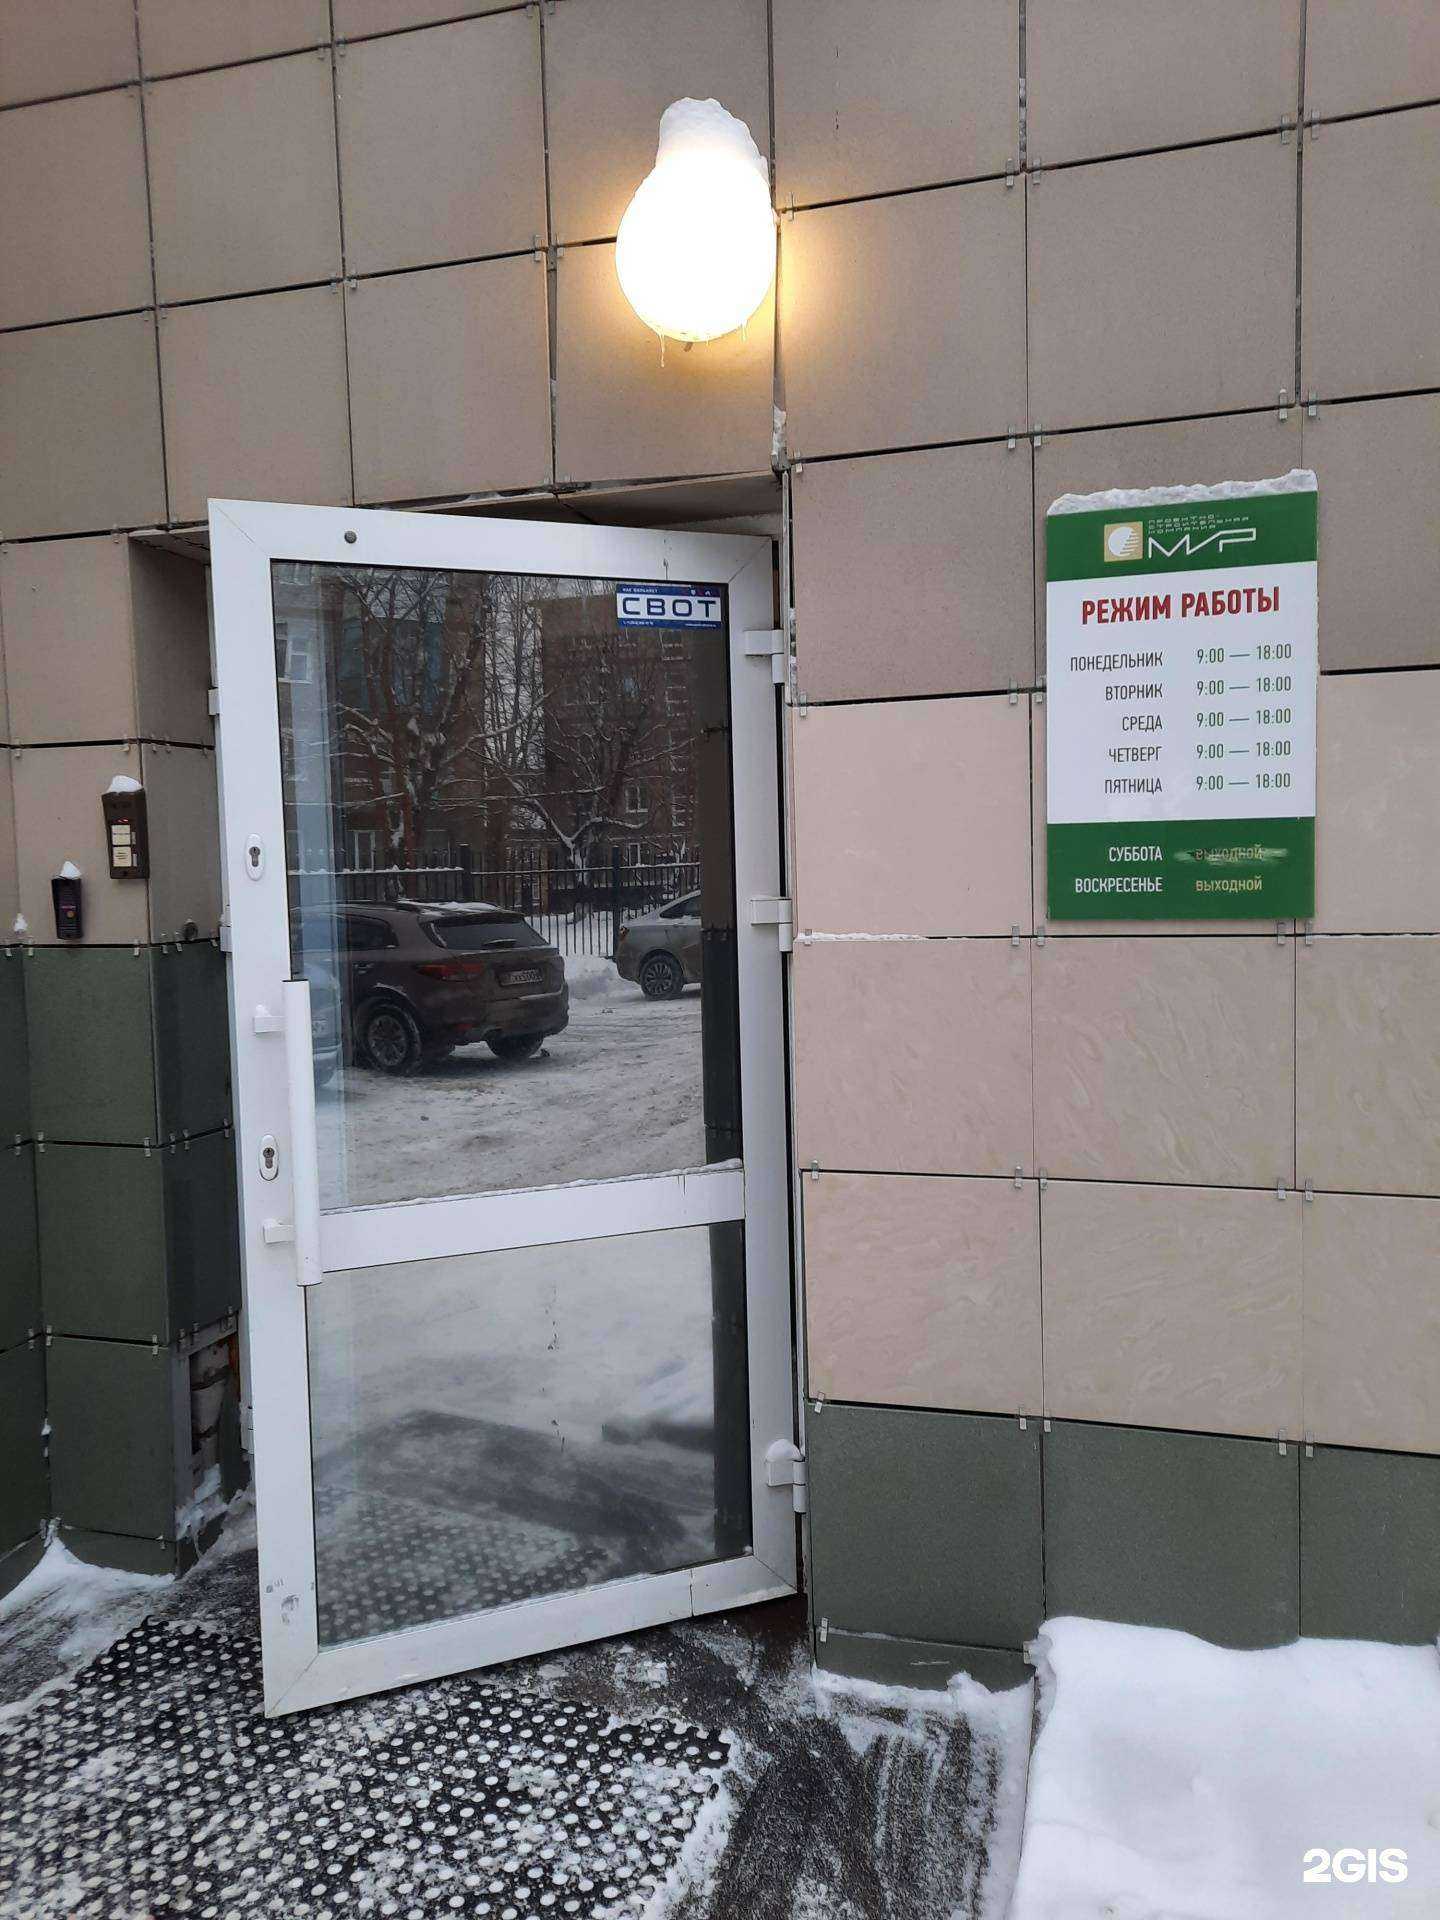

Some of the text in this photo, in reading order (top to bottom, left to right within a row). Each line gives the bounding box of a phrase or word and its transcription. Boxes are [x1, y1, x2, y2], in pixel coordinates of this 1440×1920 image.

[1148, 527, 1256, 559] МИР
[622, 597, 717, 618] СВОТ
[1082, 586, 1280, 625] РЕЖИМ РАБОТЫ
[1070, 651, 1163, 673] ПОНЕДЕЛЬНИК
[1197, 647, 1225, 664] 9:00
[1256, 643, 1292, 661] 18:00
[1105, 683, 1163, 701] ВТОРНИК
[1197, 679, 1225, 696] 9:00
[1256, 676, 1292, 693] 18:00
[1122, 715, 1163, 732] СРЕДА
[1197, 712, 1225, 727] 9:00
[1256, 708, 1292, 724] 18:00
[1109, 746, 1163, 763] ЧЕТВЕРГ
[1197, 743, 1225, 759] 9:00
[1256, 740, 1292, 756] 18:00
[1104, 777, 1163, 795] ПЯТНИЦА
[1196, 775, 1224, 791] 9:00
[1255, 772, 1291, 789] 18:00
[1109, 846, 1163, 862] СУББОТА
[1075, 877, 1163, 894] ВОСКРЕСЕНЬЕ
